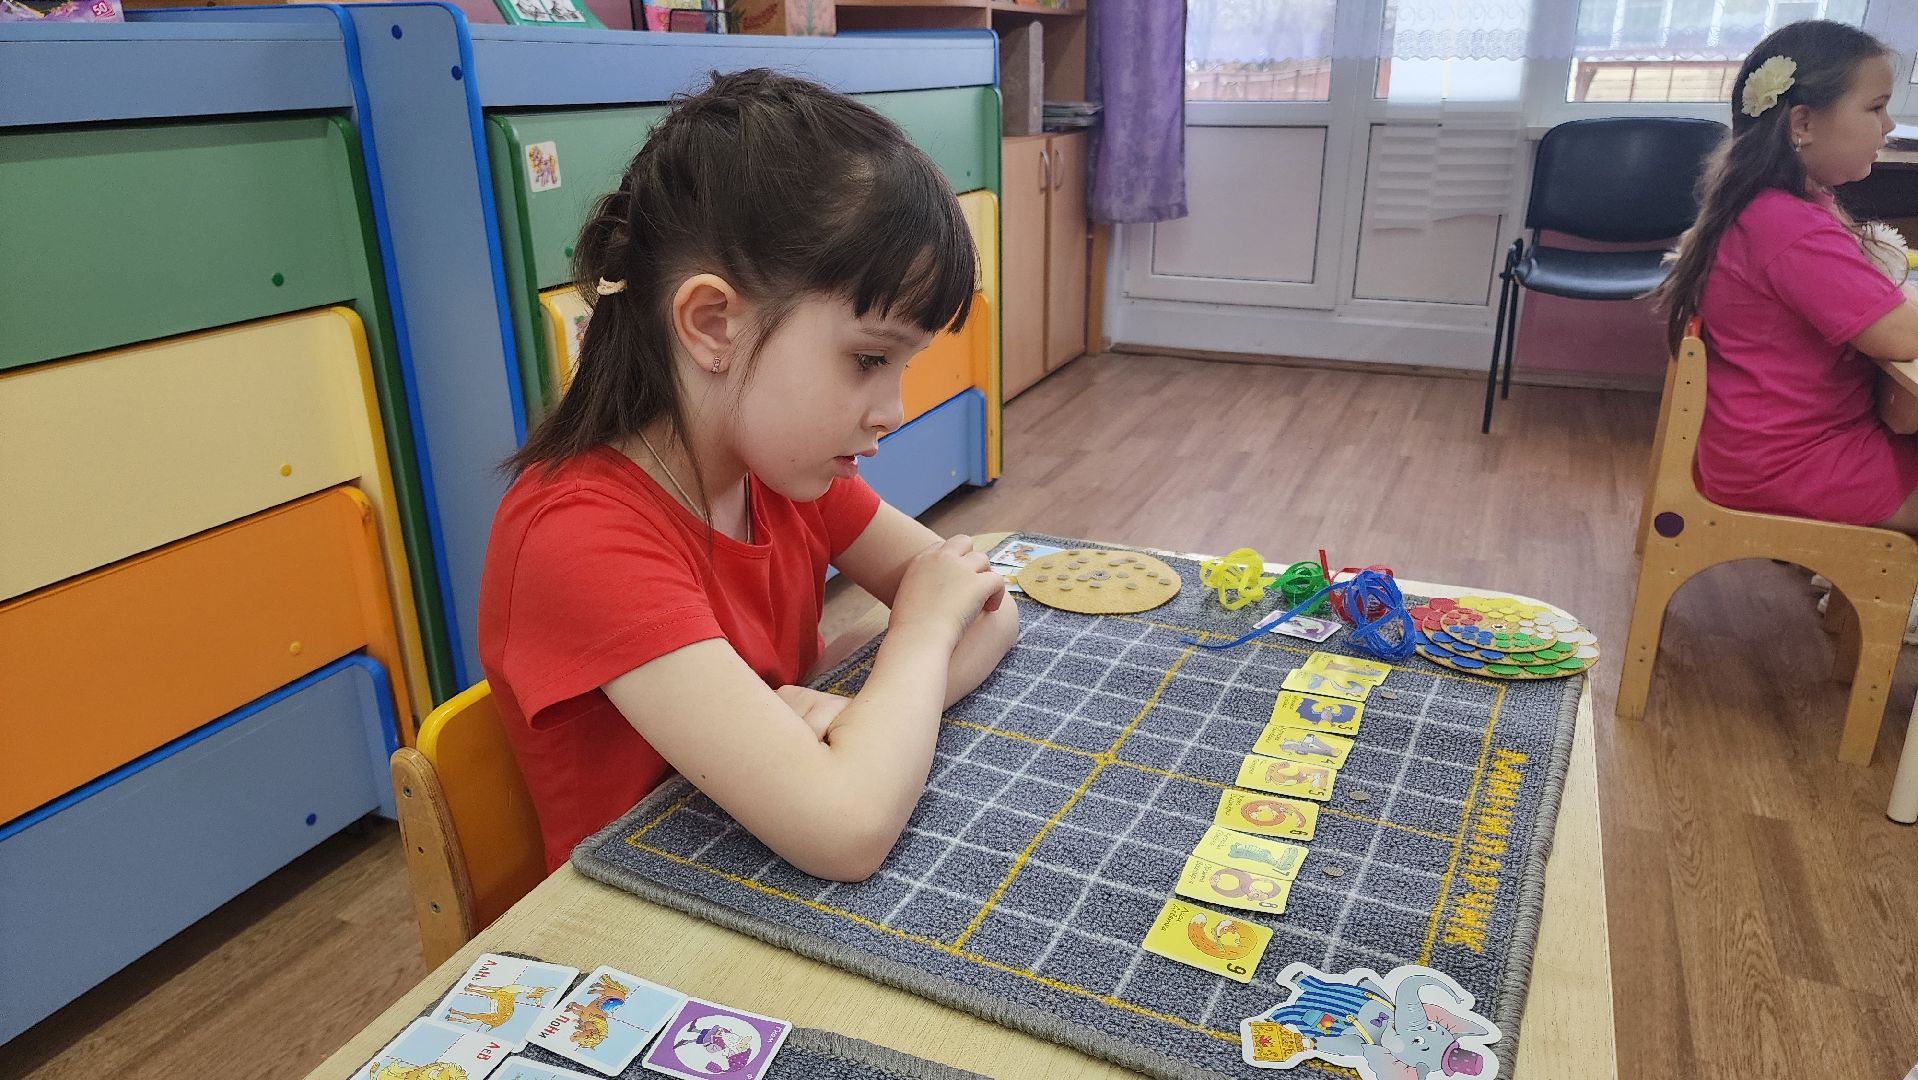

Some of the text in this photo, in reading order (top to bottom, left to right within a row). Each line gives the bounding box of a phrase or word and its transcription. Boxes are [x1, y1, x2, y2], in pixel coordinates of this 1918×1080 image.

[92, 2, 108, 16] 50
[1338, 724, 1354, 732] 3
[1259, 901, 1278, 909] 8
[1226, 962, 1247, 975] 9
